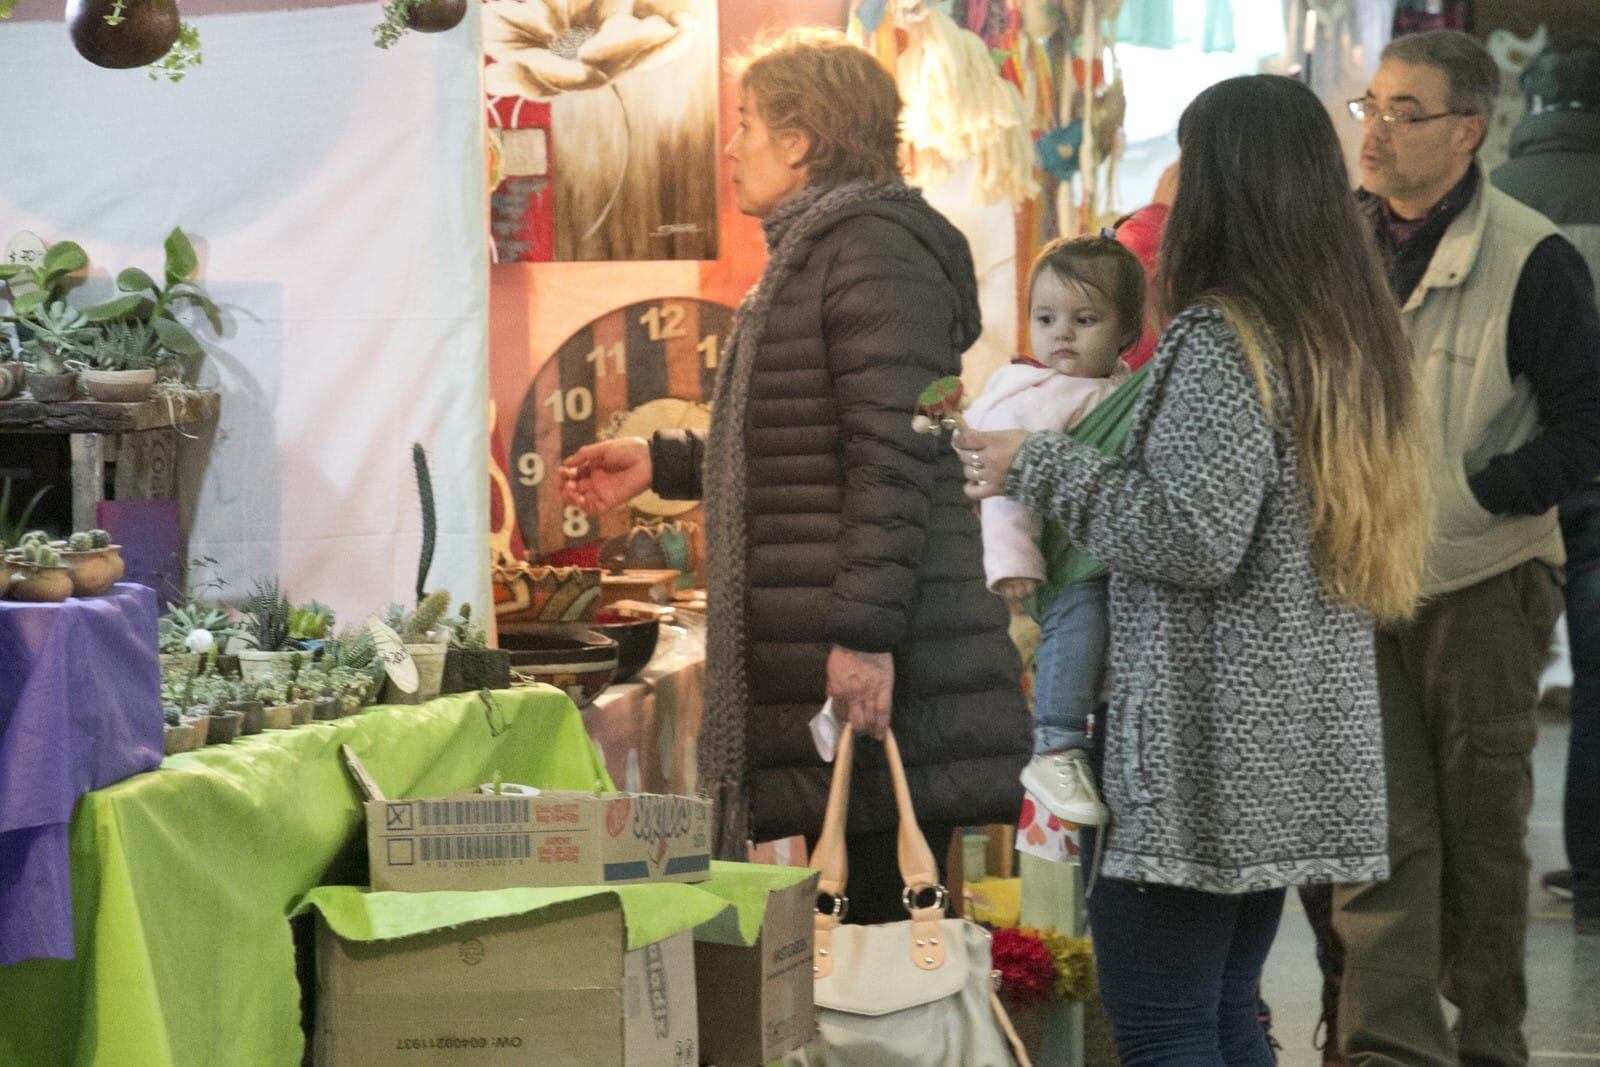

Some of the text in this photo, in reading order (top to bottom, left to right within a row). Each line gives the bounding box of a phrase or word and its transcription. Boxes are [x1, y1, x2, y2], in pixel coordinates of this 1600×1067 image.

[639, 305, 687, 341] 12
[586, 342, 626, 377] 11
[697, 335, 718, 369] 1
[544, 386, 593, 423] 10
[517, 452, 545, 486] 9
[562, 506, 590, 538] 8
[491, 1036, 523, 1048] OW:
